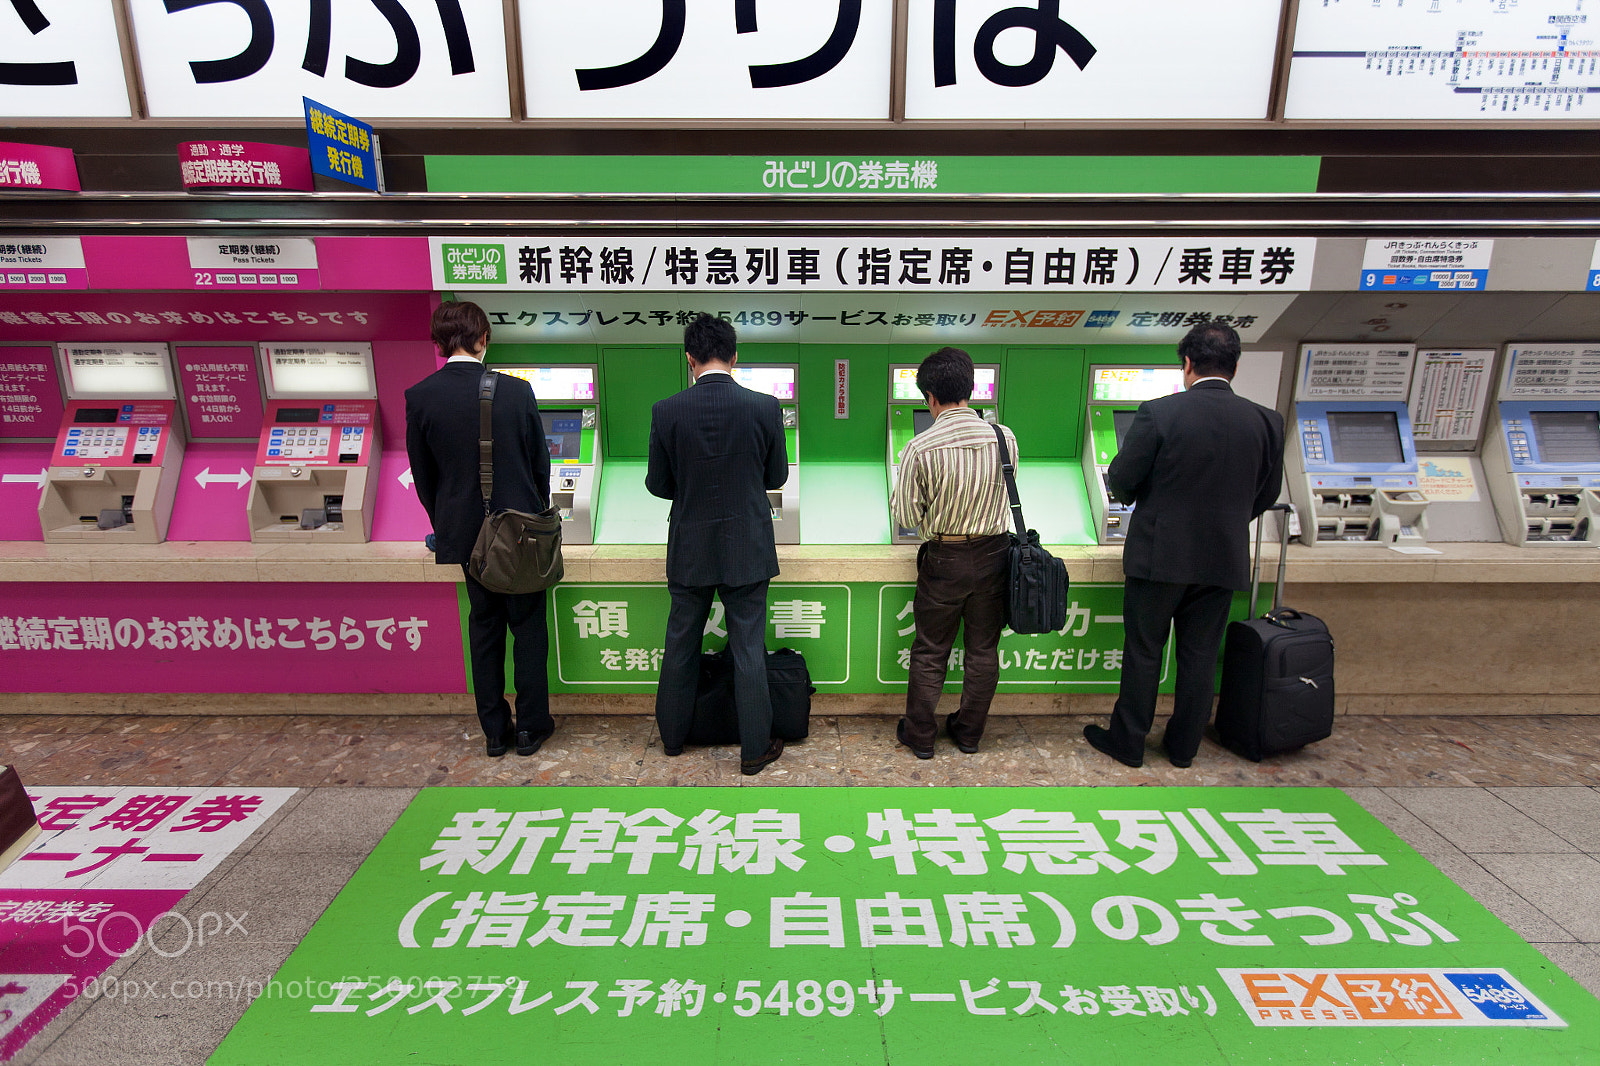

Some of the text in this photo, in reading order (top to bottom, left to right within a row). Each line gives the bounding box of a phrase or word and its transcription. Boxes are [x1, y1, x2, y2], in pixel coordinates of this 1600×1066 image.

[309, 106, 371, 152] 継続定期券
[190, 144, 245, 157] 通勤・通学
[327, 145, 364, 180] 発行機
[762, 160, 938, 190] みどりの券売機
[218, 244, 281, 255] 定期券(継続)
[1384, 241, 1478, 249] JRきっぷ・れんらくきっぷ
[447, 248, 500, 264] みどりの
[194, 272, 213, 286] 22
[452, 264, 498, 281] 券売機
[1366, 273, 1376, 287] 9
[1593, 274, 1600, 287] 8
[0, 311, 369, 325] 継続定期のお求めはこちらです
[488, 309, 977, 328] エクスプレス予約5489サービスお受取り
[195, 374, 247, 382] スピーディーに
[200, 405, 241, 413] 14日前から
[28, 794, 264, 833] 定期券
[420, 807, 1389, 877] 新幹線・特急列車
[397, 891, 1460, 949] (指定席・自由席)のきっぷ
[310, 976, 1218, 1018] エクスプレス予約・5489サービスお受取り
[1462, 988, 1525, 1004] 5489
